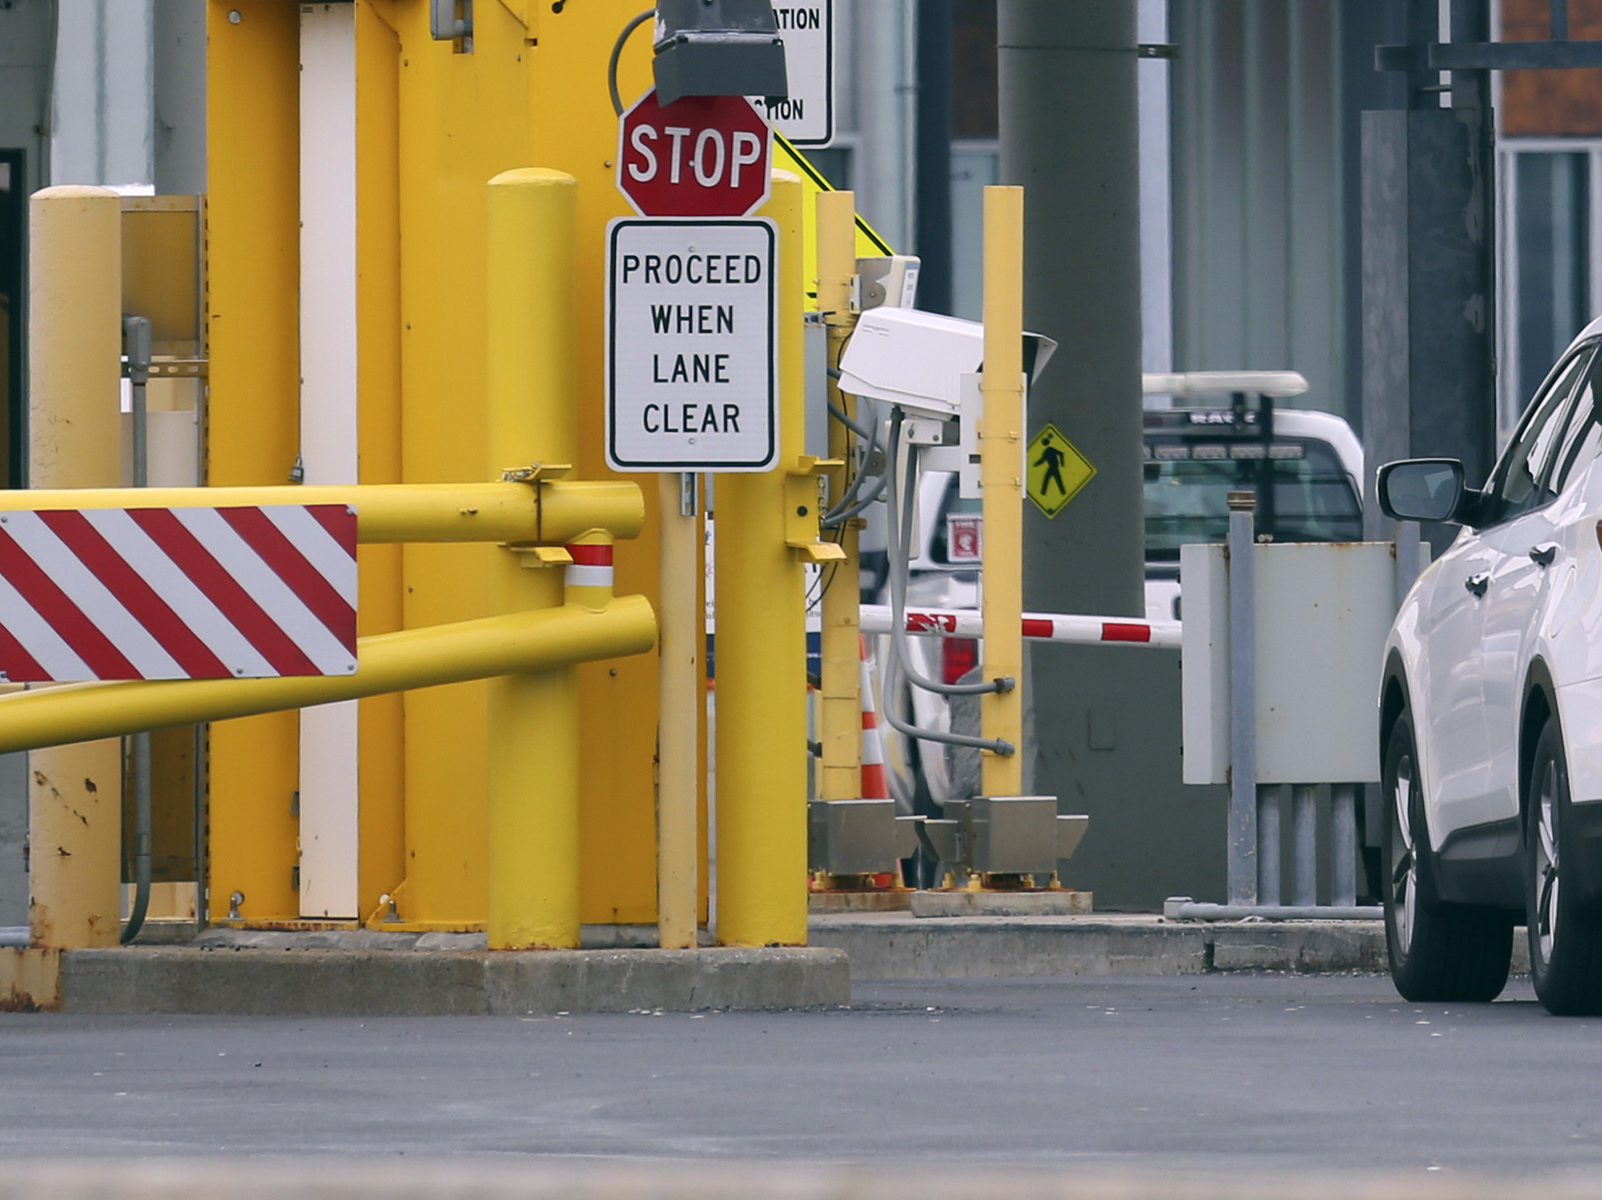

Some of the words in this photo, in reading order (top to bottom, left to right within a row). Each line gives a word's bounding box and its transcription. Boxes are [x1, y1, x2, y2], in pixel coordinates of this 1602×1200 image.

[627, 124, 761, 189] STOP
[622, 255, 761, 284] PROCEED
[651, 305, 734, 334] WHEN
[652, 354, 730, 383] LANE
[643, 404, 741, 433] CLEAR
